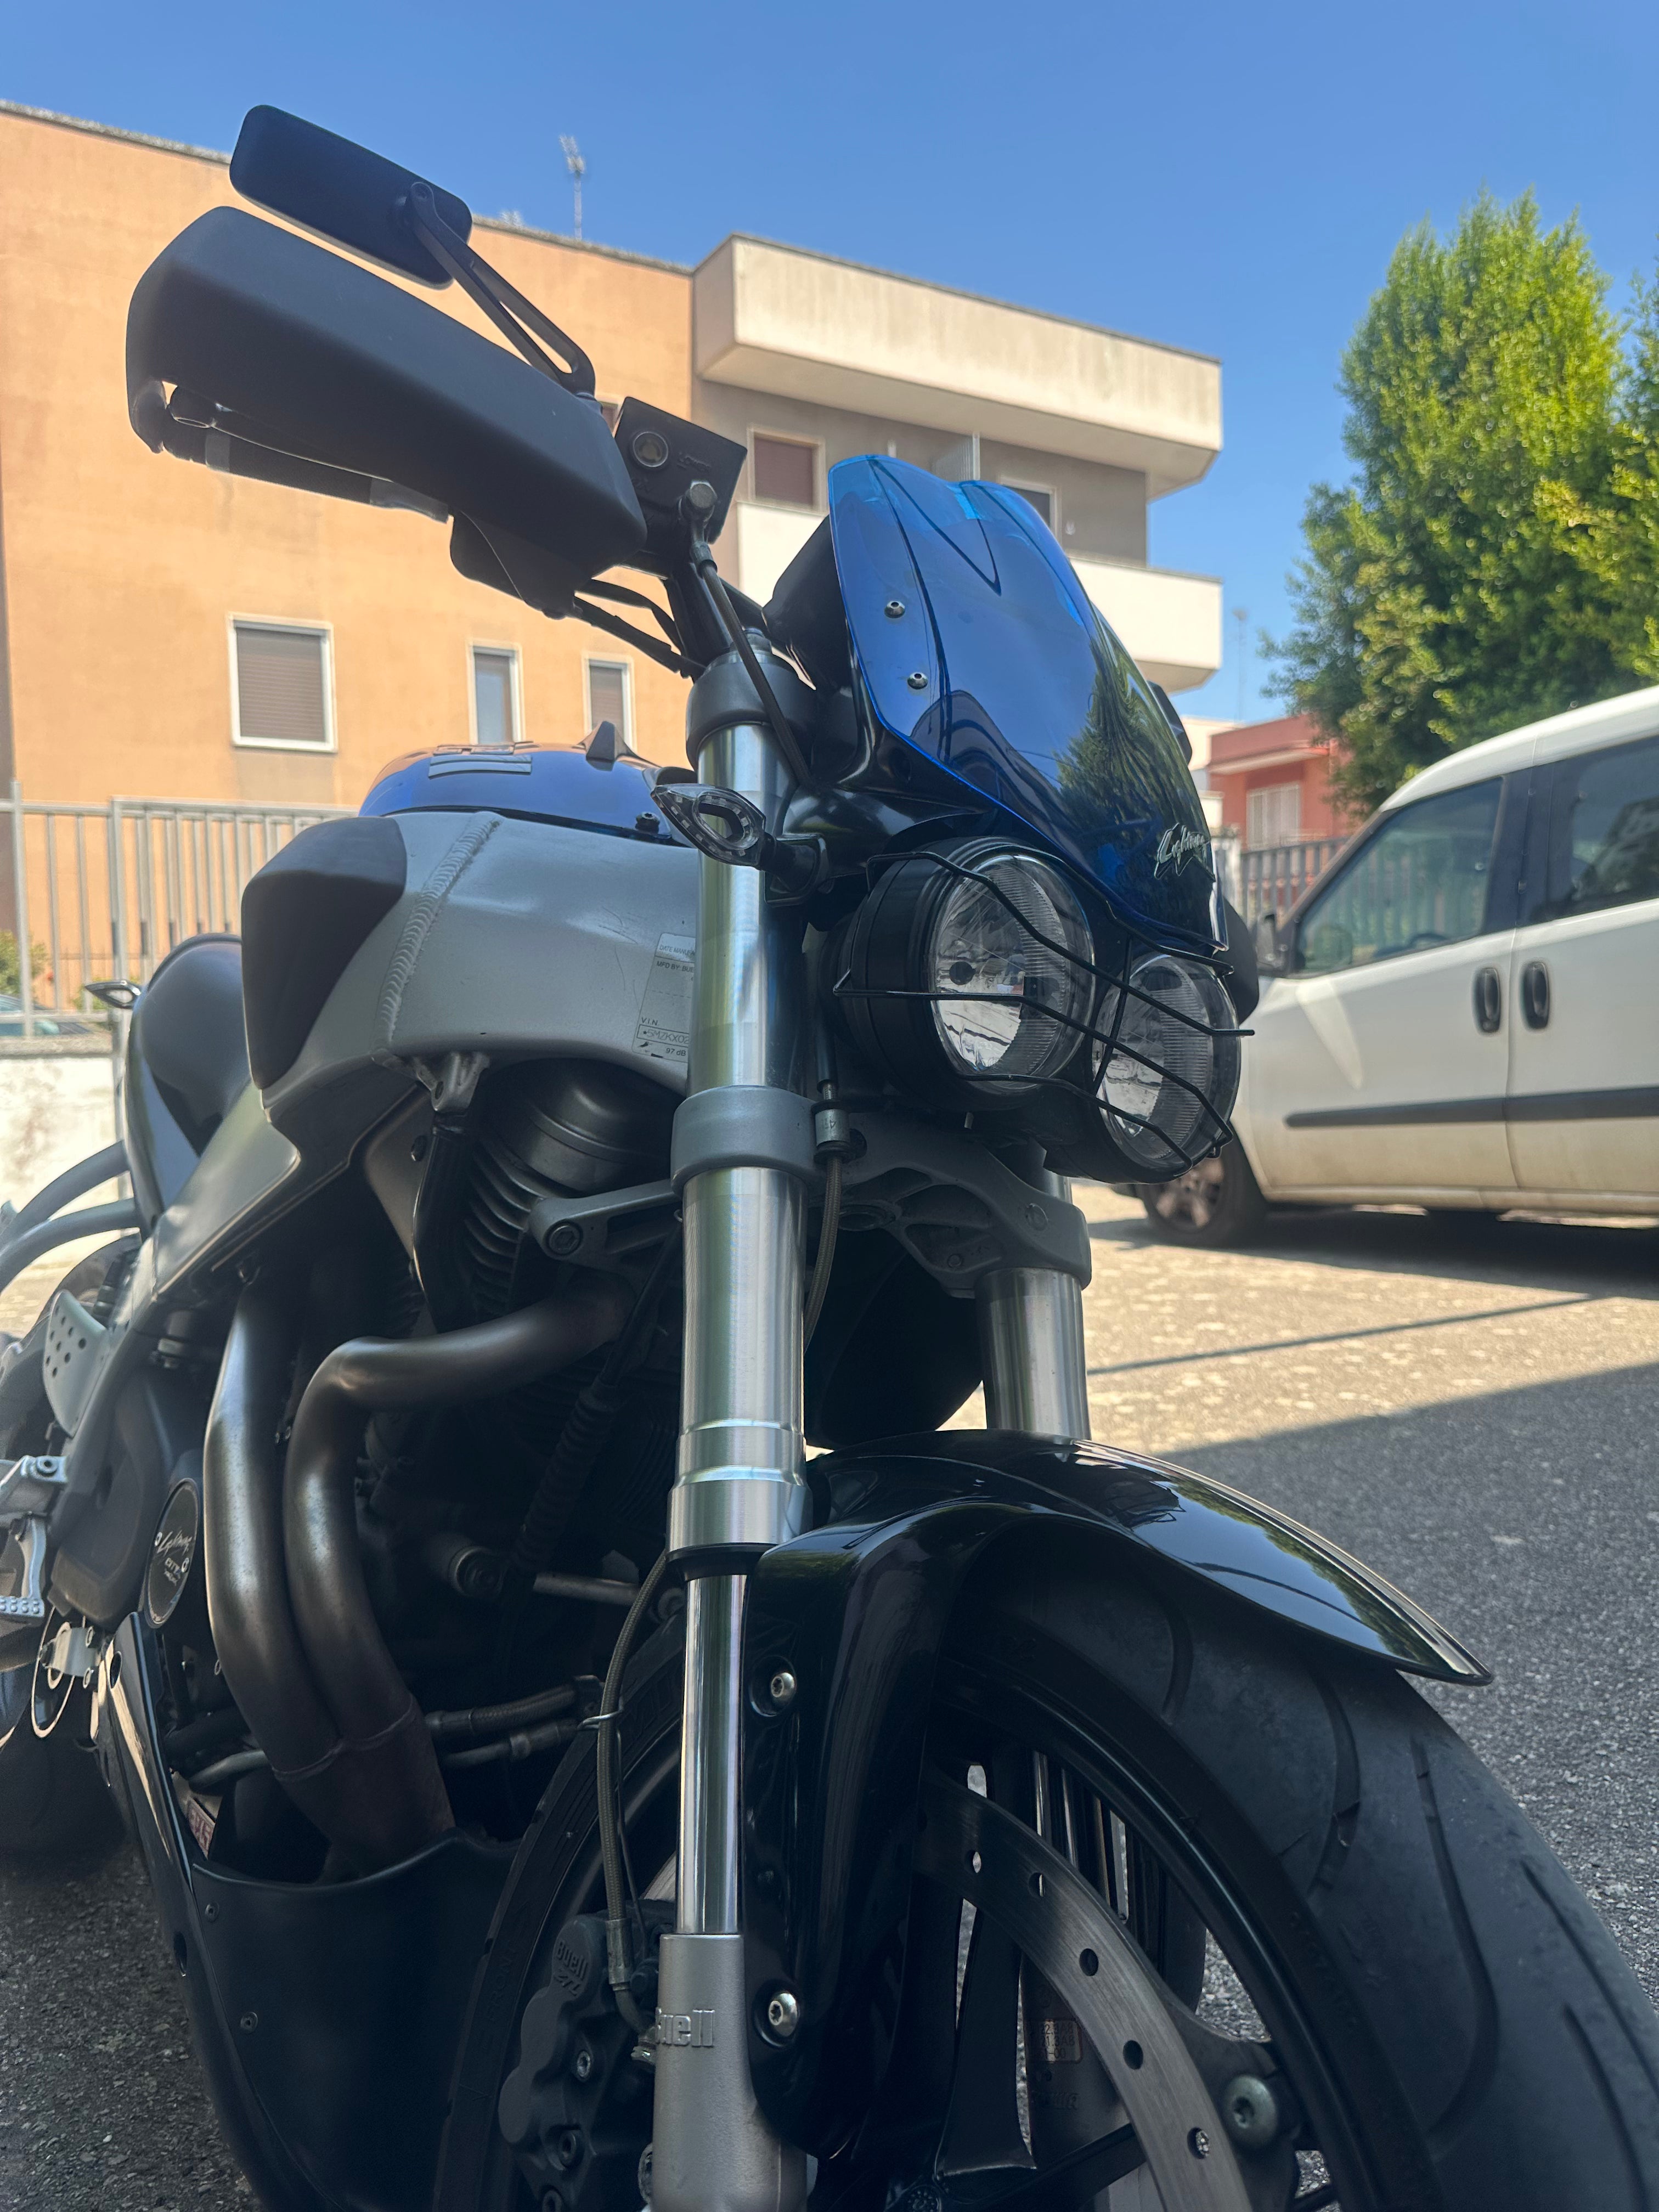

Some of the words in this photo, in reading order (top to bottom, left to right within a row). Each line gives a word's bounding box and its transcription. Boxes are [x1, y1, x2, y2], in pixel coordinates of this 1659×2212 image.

[659, 944, 673, 952] DATE
[656, 961, 670, 969] MFD
[556, 1939, 589, 1980] Buell
